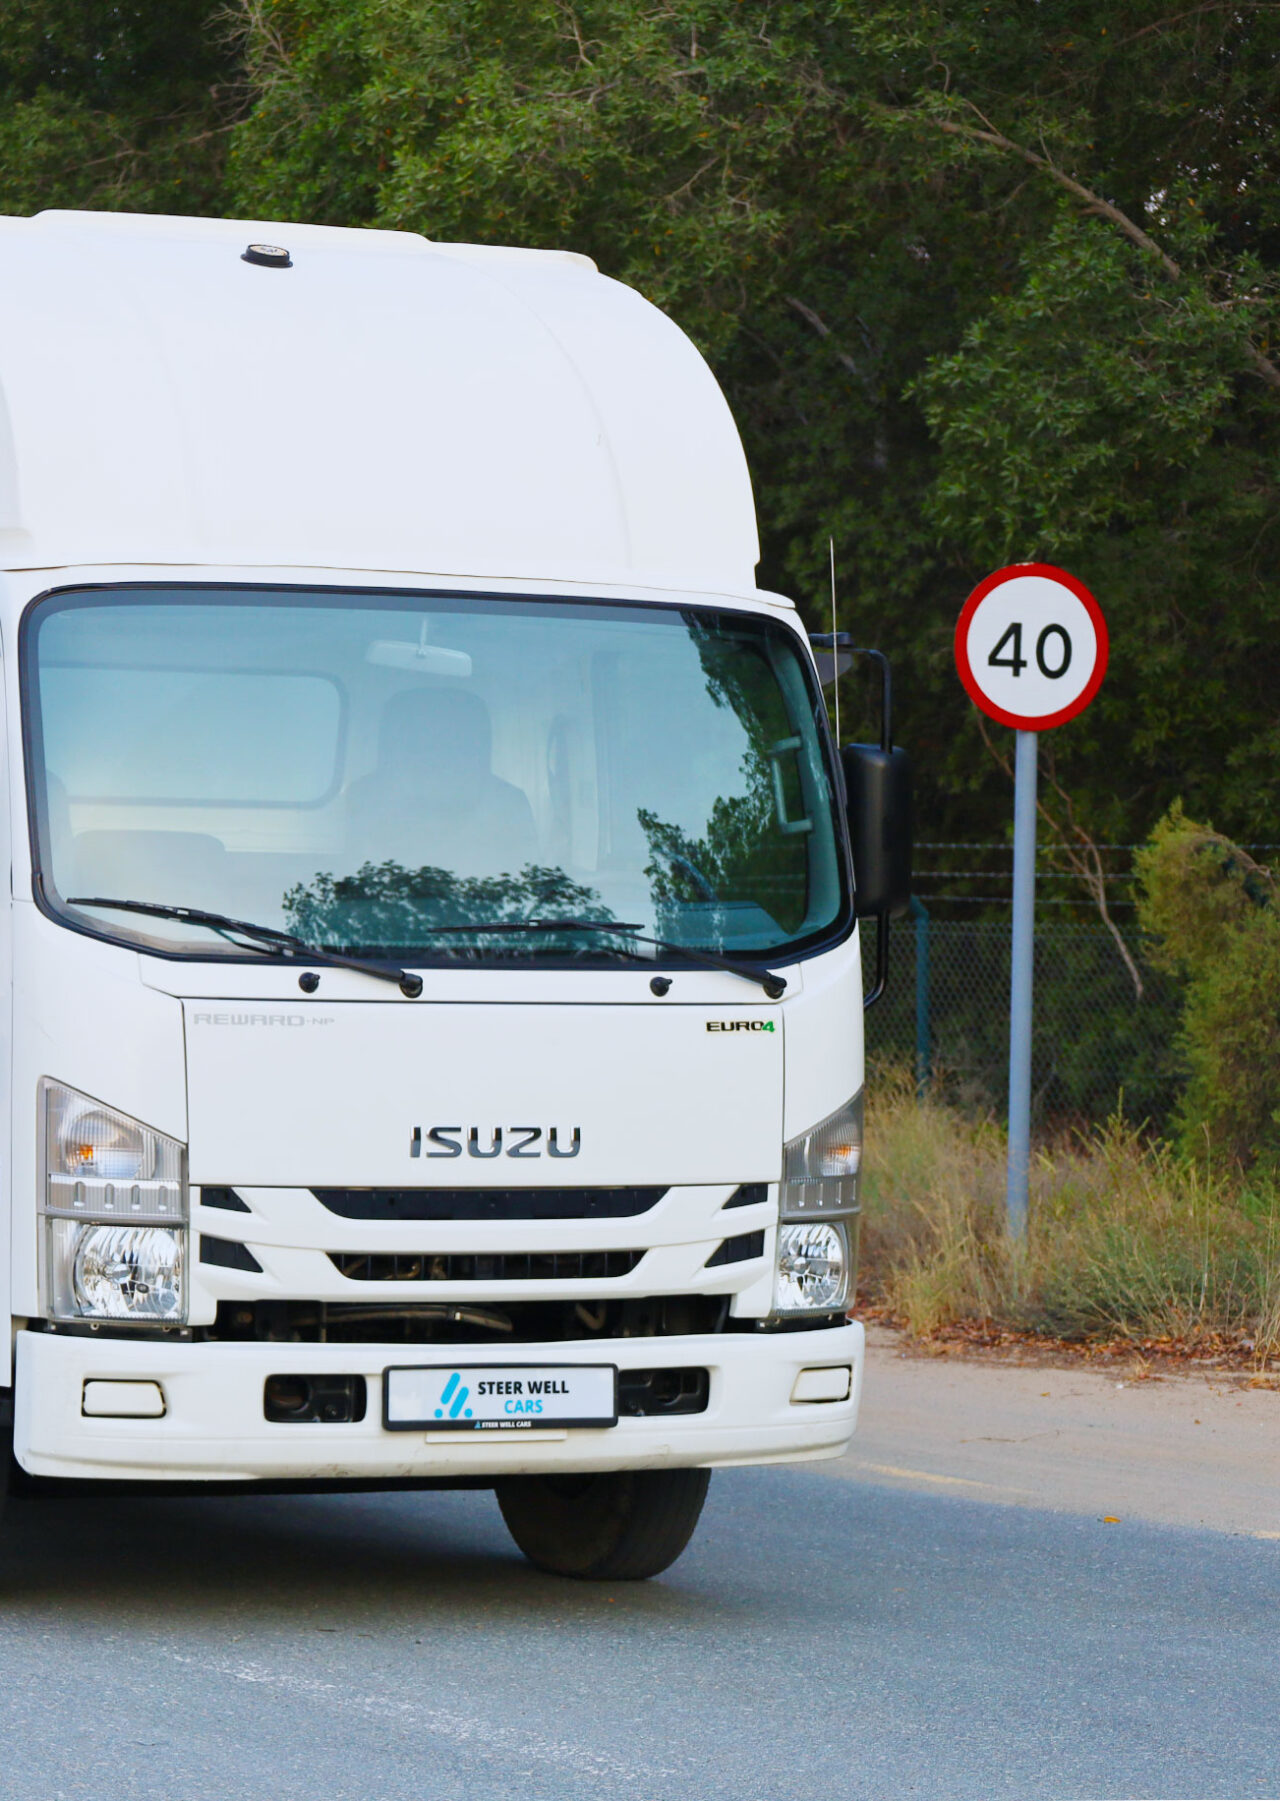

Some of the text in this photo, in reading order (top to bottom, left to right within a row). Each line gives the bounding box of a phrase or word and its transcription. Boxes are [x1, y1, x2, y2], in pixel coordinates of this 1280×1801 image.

[988, 622, 1073, 680] 40
[409, 1126, 581, 1159] ISUZU
[477, 1380, 570, 1396] STEER WELL
[504, 1399, 543, 1414] CARS
[481, 1421, 499, 1429] STEER
[516, 1420, 532, 1428] CARS
